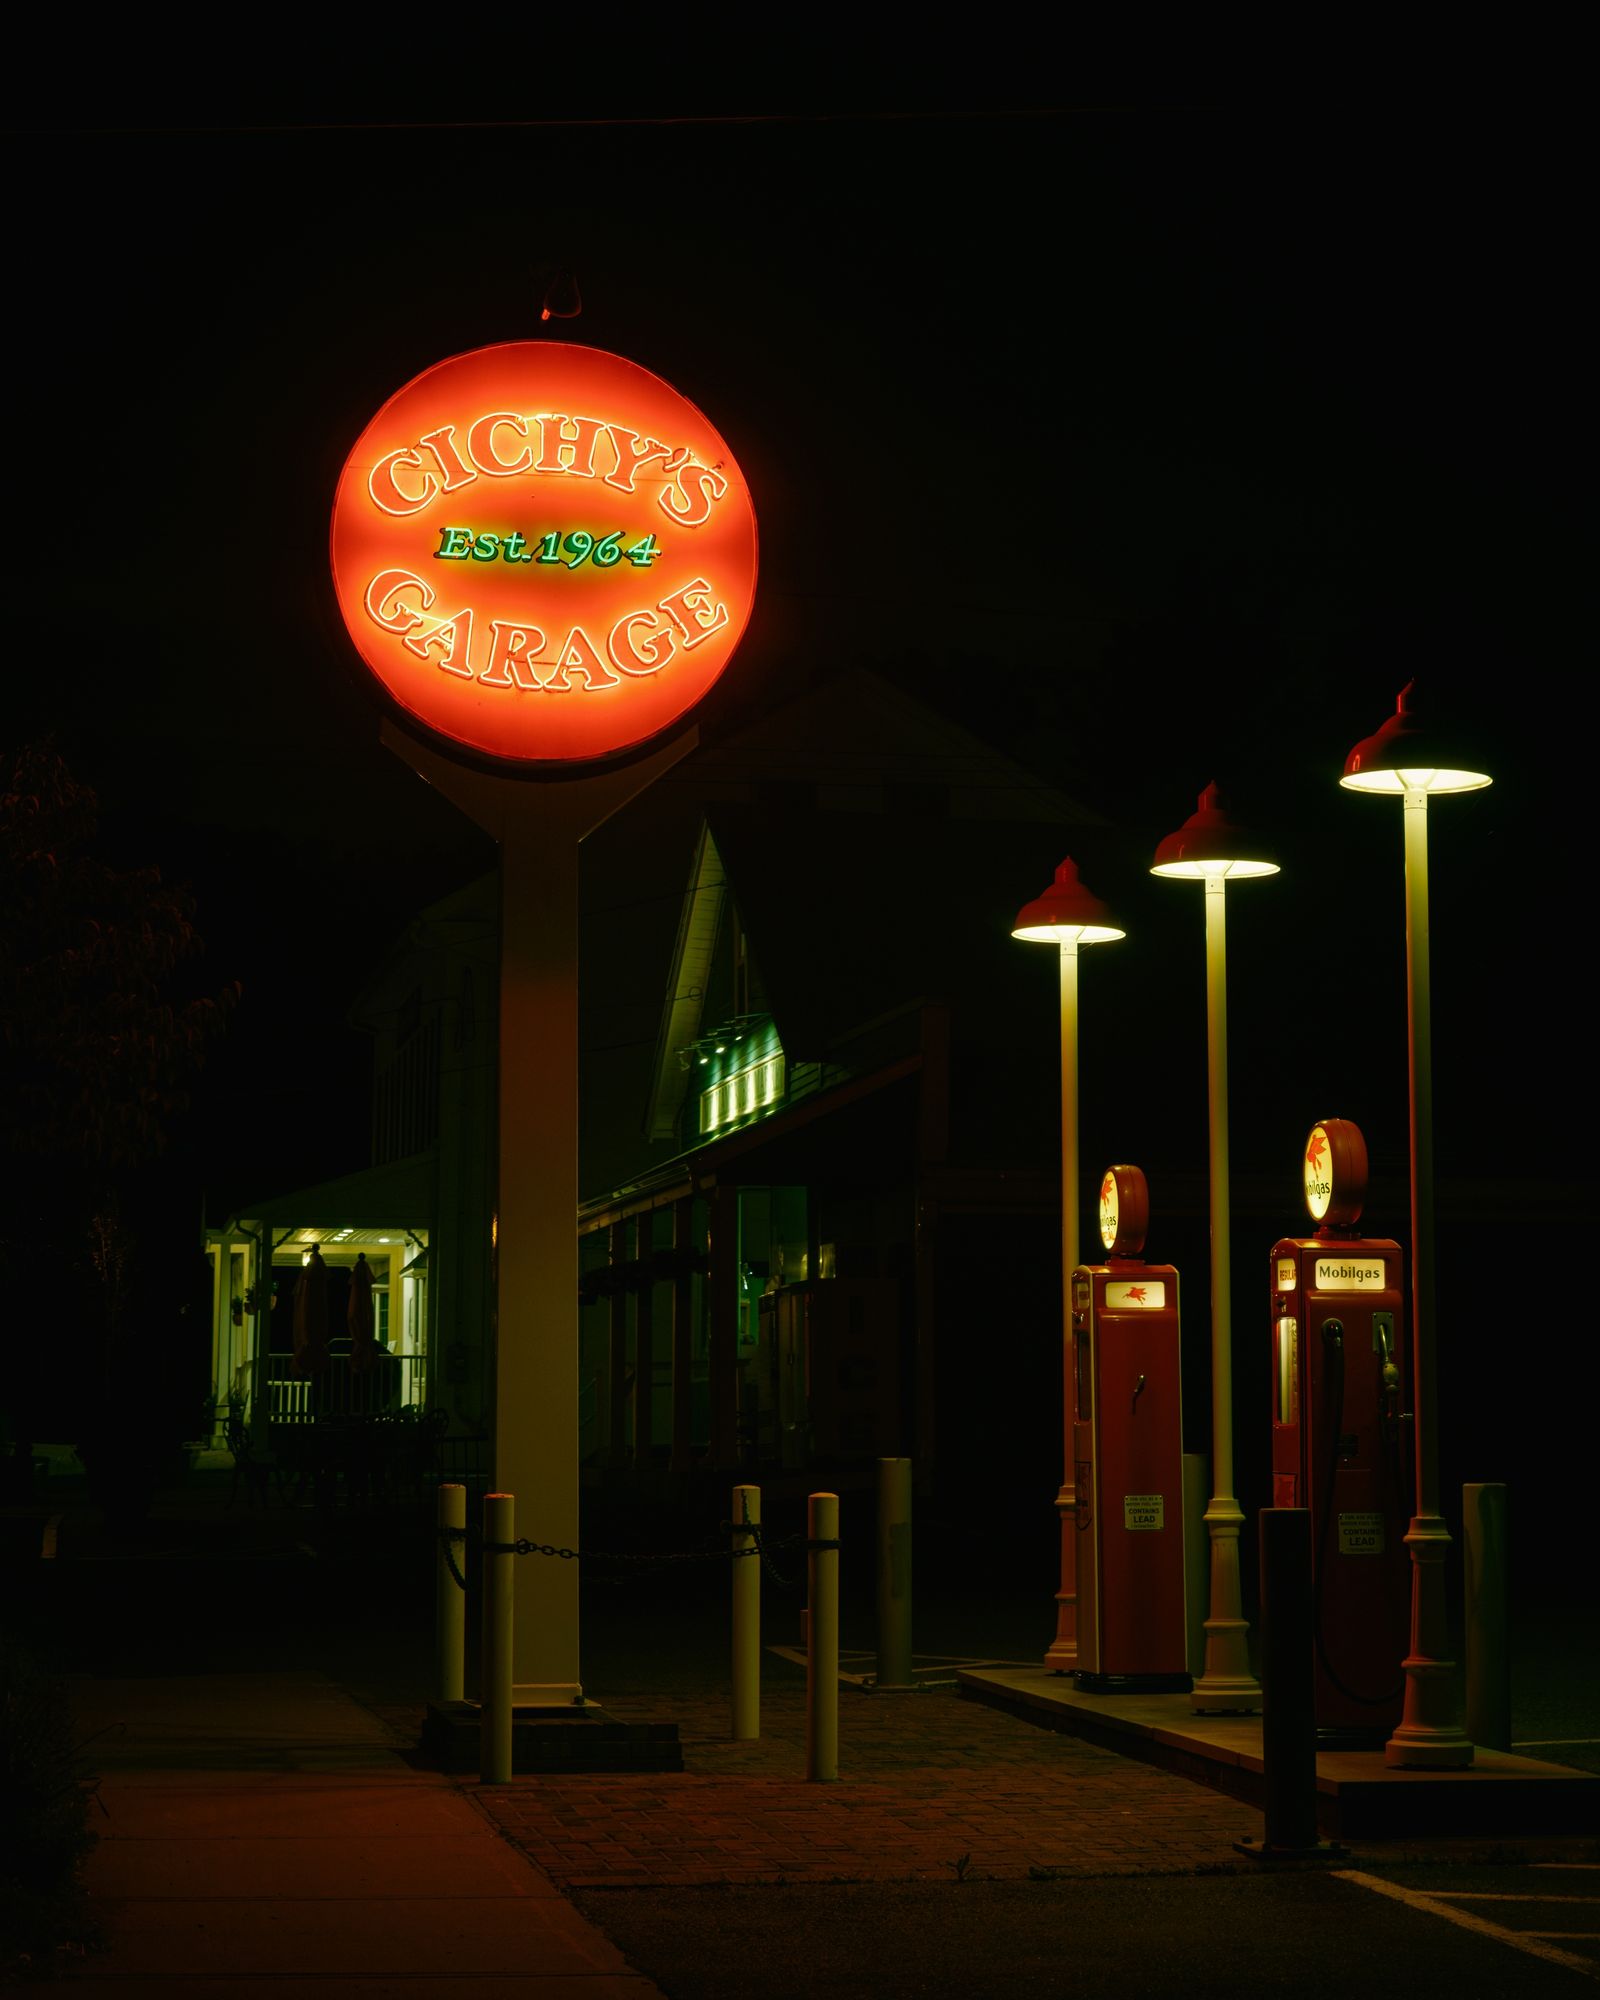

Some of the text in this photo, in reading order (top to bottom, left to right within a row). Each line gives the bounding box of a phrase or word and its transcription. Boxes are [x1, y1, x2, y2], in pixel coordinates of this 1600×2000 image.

[368, 412, 728, 526] CICHY'S
[366, 568, 730, 691] GARAGE
[1319, 1265, 1380, 1283] Mobilgas
[1133, 1515, 1155, 1523] LEAD
[1349, 1536, 1375, 1546] LEAD
